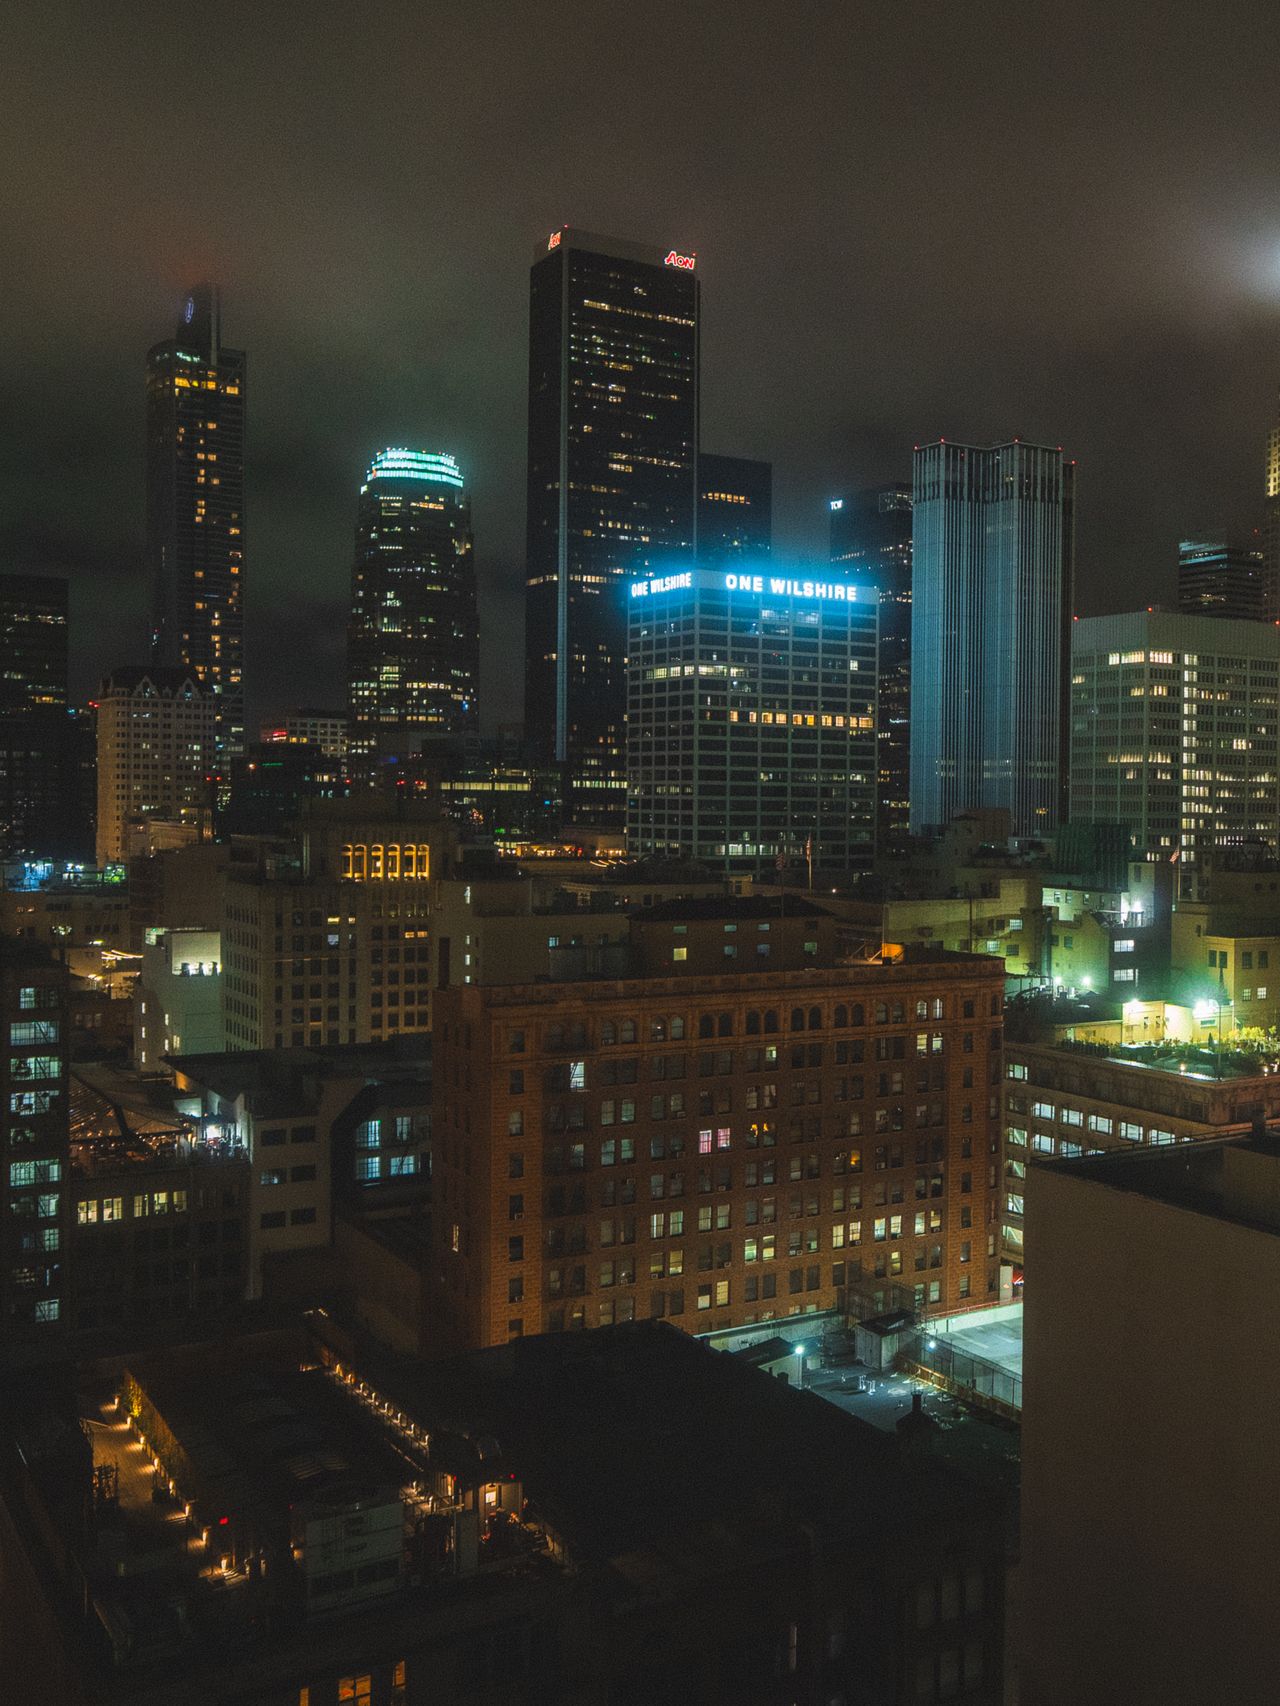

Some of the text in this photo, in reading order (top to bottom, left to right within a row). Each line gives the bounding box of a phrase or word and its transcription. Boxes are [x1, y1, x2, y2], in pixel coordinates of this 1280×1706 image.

[830, 500, 843, 510] TCW
[631, 573, 692, 597] ONE WILSHIRE
[726, 574, 857, 601] ONE WILSHIRE
